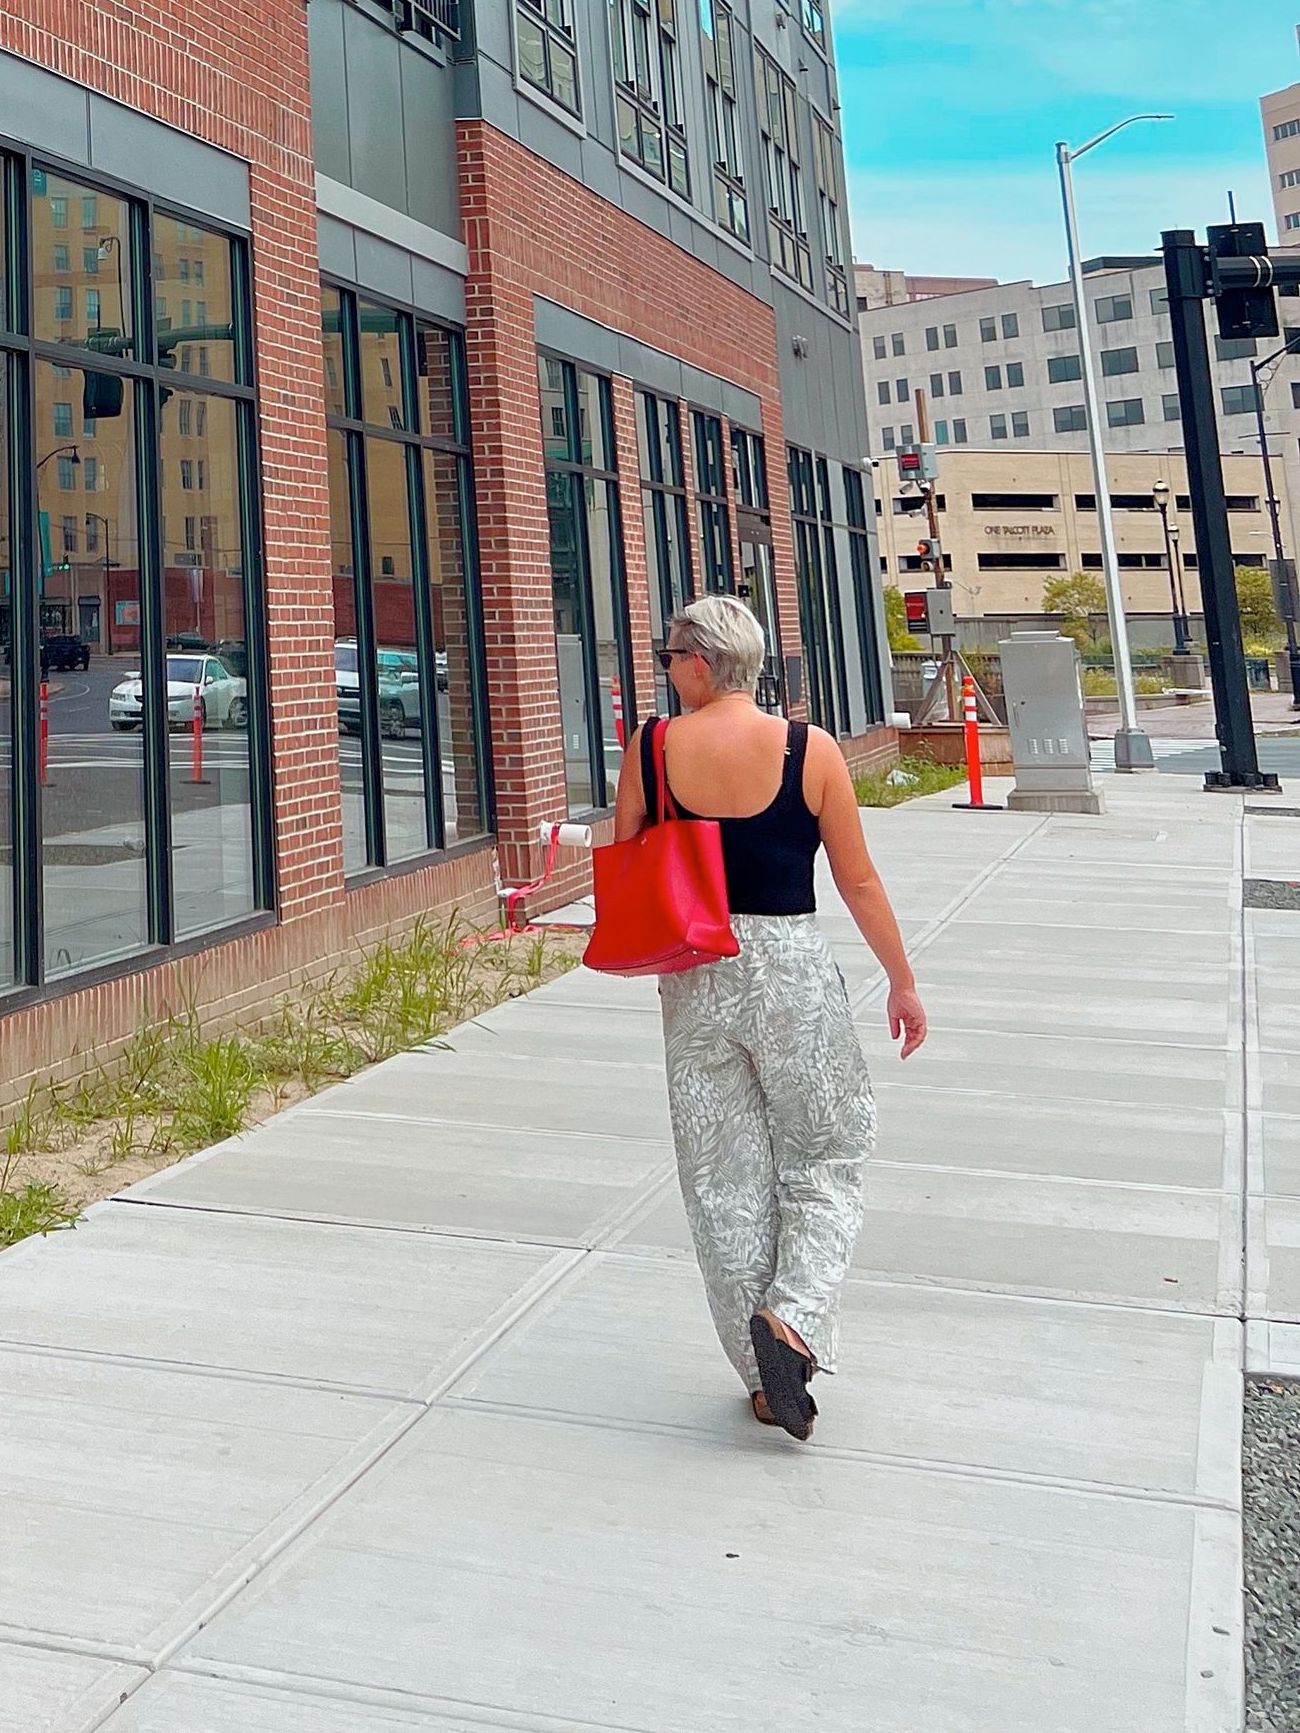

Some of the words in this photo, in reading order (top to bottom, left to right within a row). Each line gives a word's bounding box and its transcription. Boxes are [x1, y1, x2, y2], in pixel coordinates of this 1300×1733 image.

[984, 525, 1000, 535] ONE
[1002, 525, 1029, 535] TALCOTT
[1031, 525, 1055, 535] PLAZA
